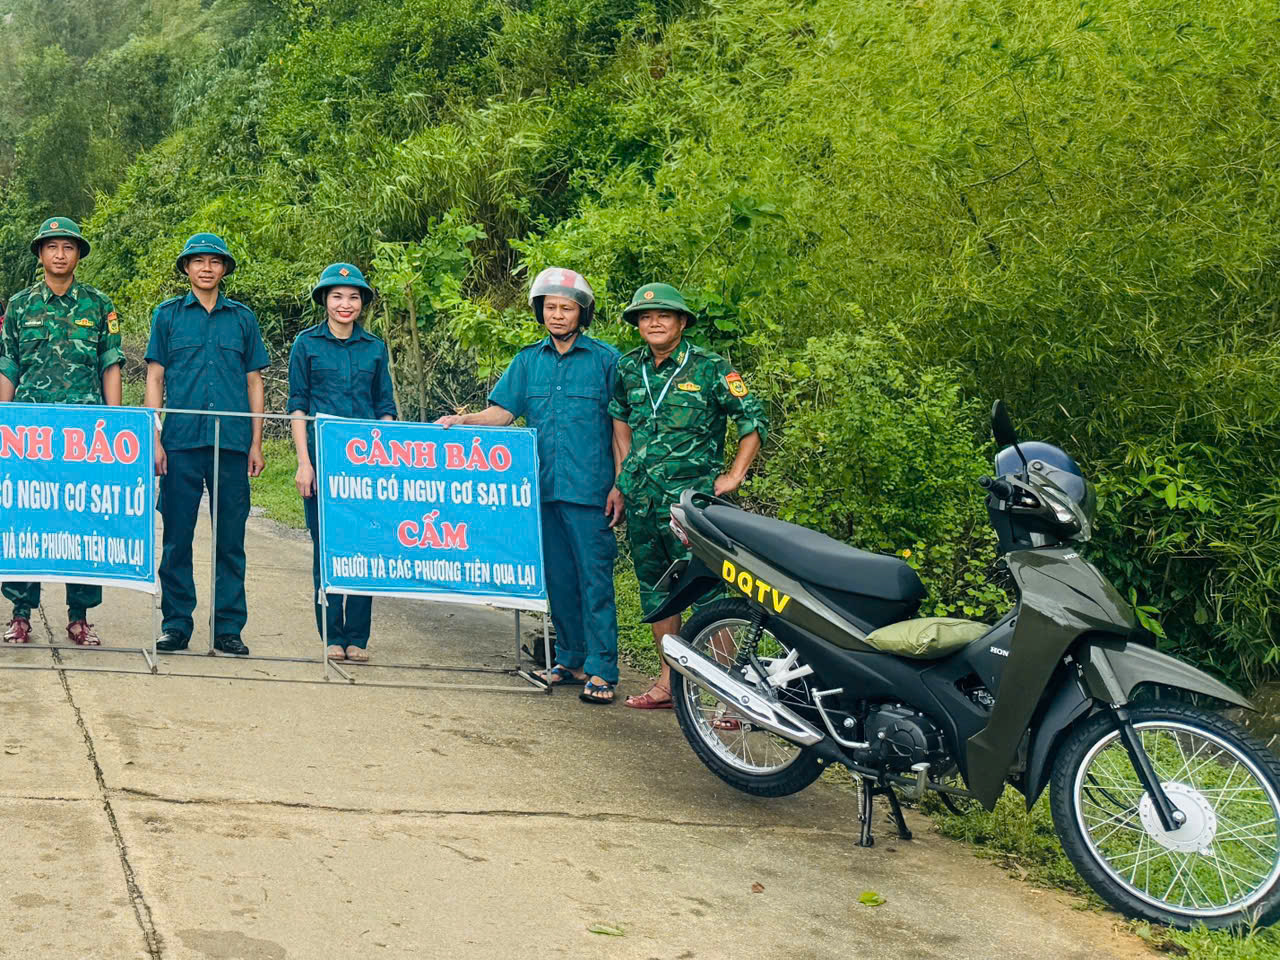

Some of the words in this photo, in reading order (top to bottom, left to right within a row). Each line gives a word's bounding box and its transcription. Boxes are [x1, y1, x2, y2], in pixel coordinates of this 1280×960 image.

[62, 420, 140, 464] BÁO
[346, 429, 436, 468] CẢNH
[444, 436, 512, 472] BÁO
[17, 480, 59, 510] NGUY
[64, 481, 86, 512] CƠ
[91, 484, 121, 520] SẠT
[125, 477, 145, 516] LỞ
[328, 471, 372, 500] VÙNG
[376, 473, 399, 501] CÓ
[403, 478, 446, 504] NGUY
[451, 479, 473, 505] CƠ
[477, 482, 507, 510] SẠT
[511, 477, 532, 507] LỞ
[2, 526, 16, 559] VÀ
[18, 526, 39, 559] CÁC
[41, 530, 81, 560] PHƯƠNG
[83, 530, 105, 567] TIỆN
[107, 536, 127, 565] QUA
[128, 538, 144, 571] LẠI
[397, 509, 468, 550] CẤM
[332, 552, 368, 578] NGƯỜI
[370, 554, 387, 579] VÀ
[389, 555, 412, 580] CÁC
[415, 559, 462, 583] PHƯƠNG
[464, 558, 491, 587] TIỆN
[493, 563, 516, 586] QUA
[518, 564, 536, 590] LẠI
[721, 559, 793, 614] DQTV
[989, 646, 1010, 657] HON
